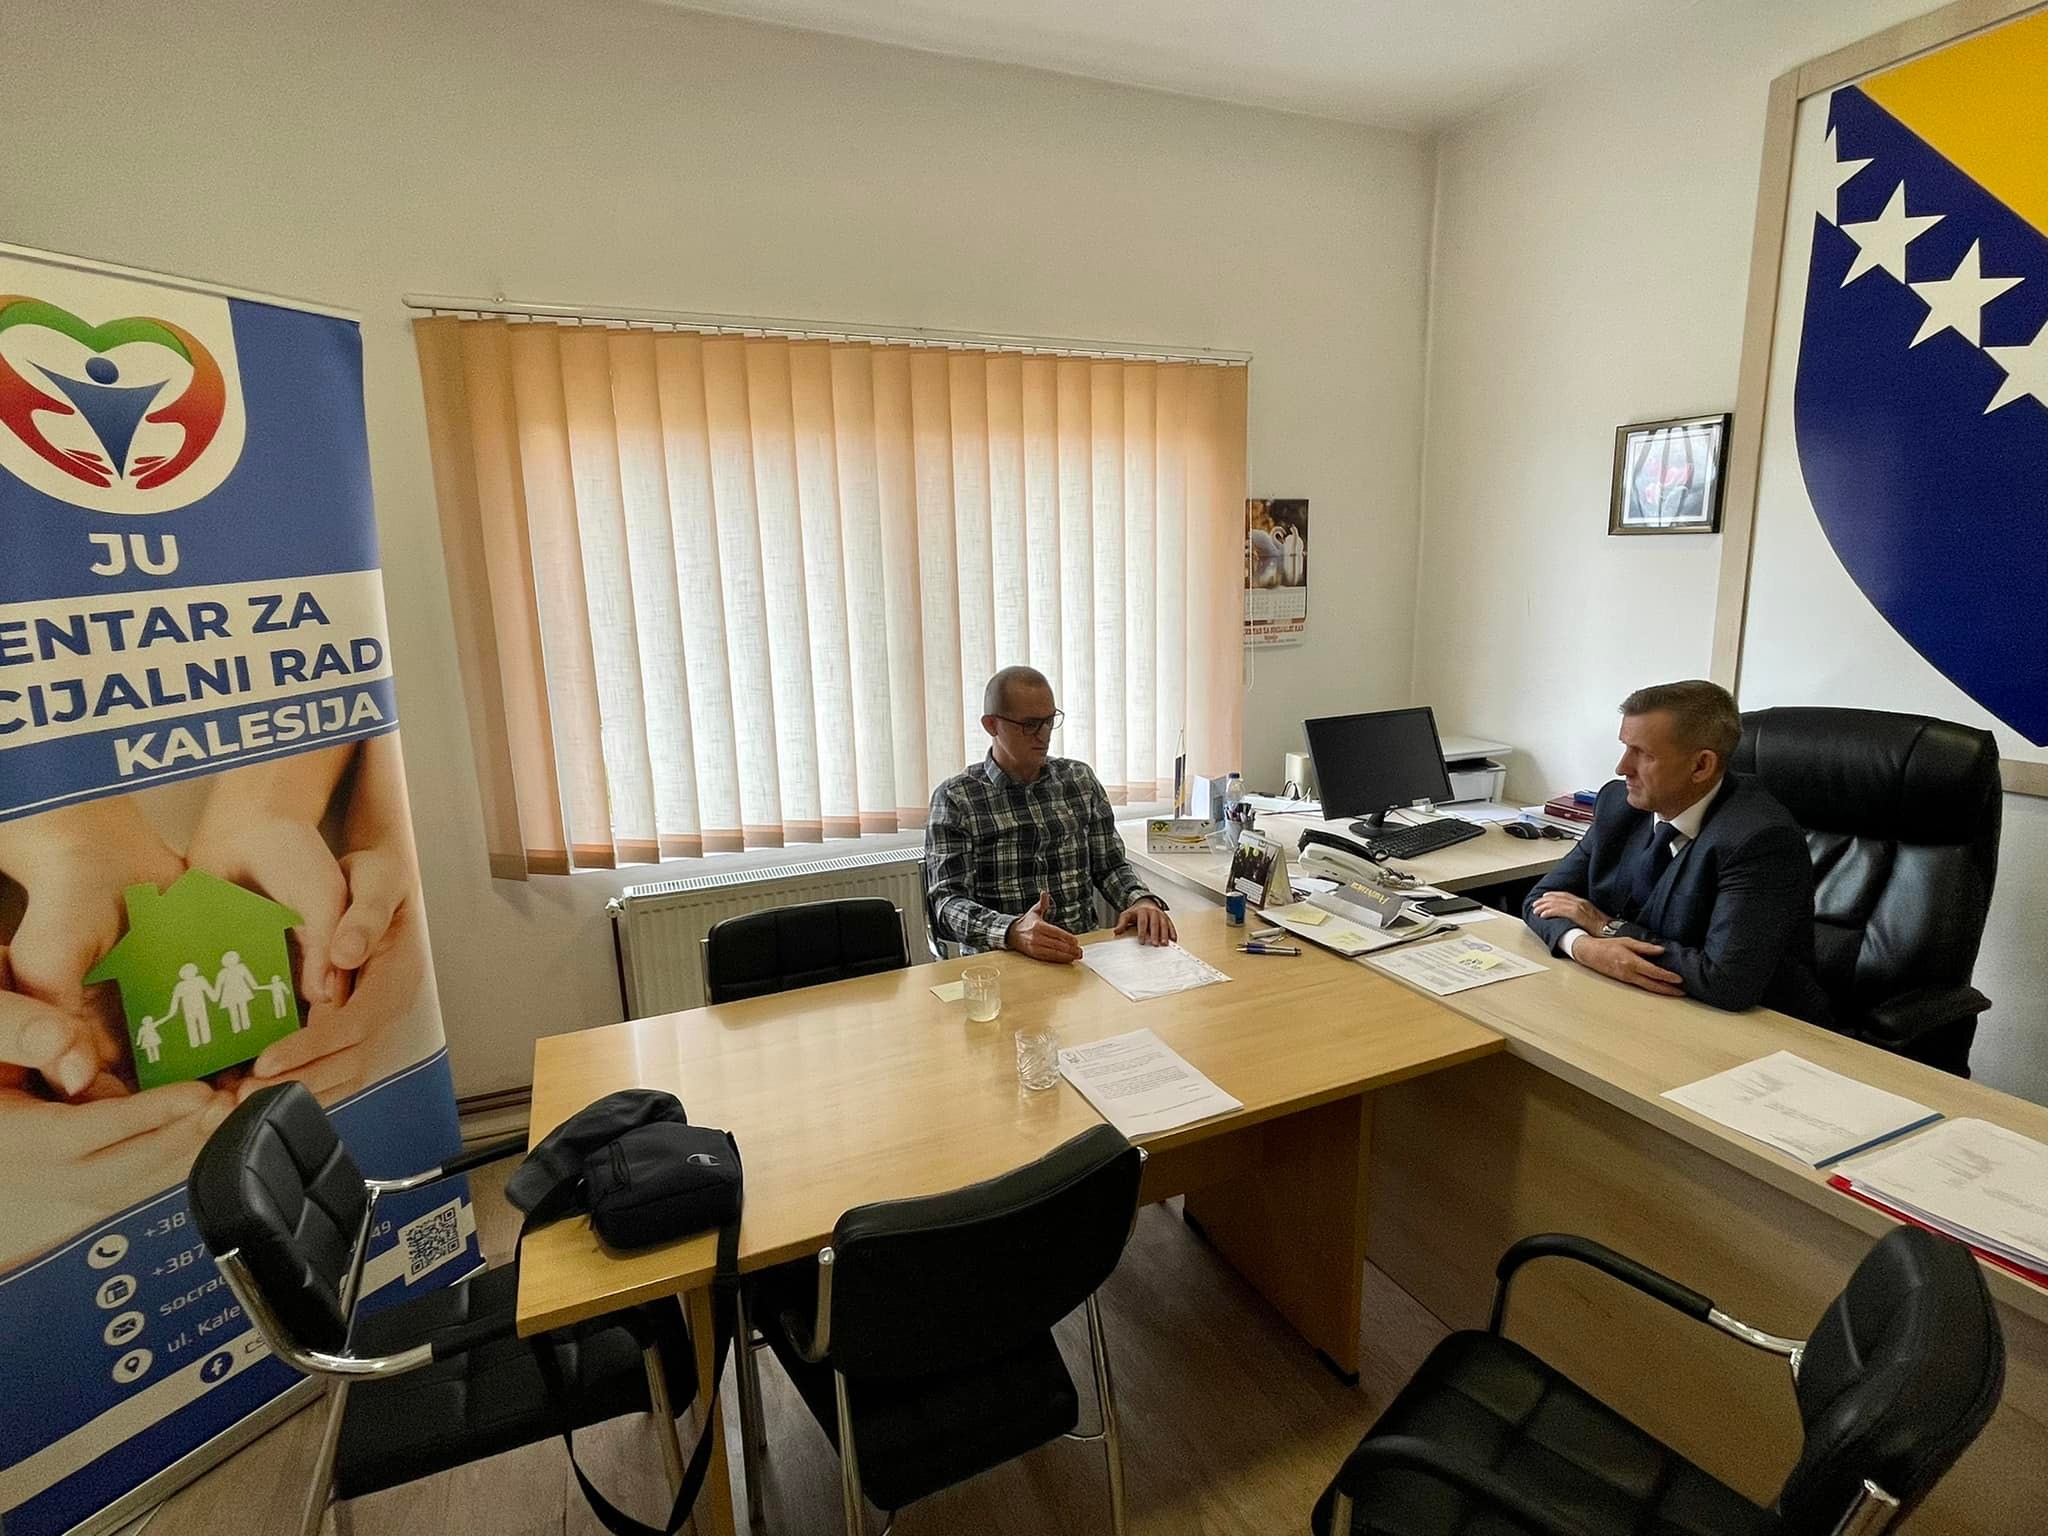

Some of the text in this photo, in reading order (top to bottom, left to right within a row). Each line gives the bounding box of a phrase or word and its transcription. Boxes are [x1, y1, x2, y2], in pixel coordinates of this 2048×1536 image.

[89, 533, 179, 576] JU
[247, 591, 330, 634] ZA
[269, 637, 384, 686] RAD
[113, 691, 384, 777] KALESIJA
[144, 1207, 190, 1238] +38
[167, 1332, 193, 1352] ul.
